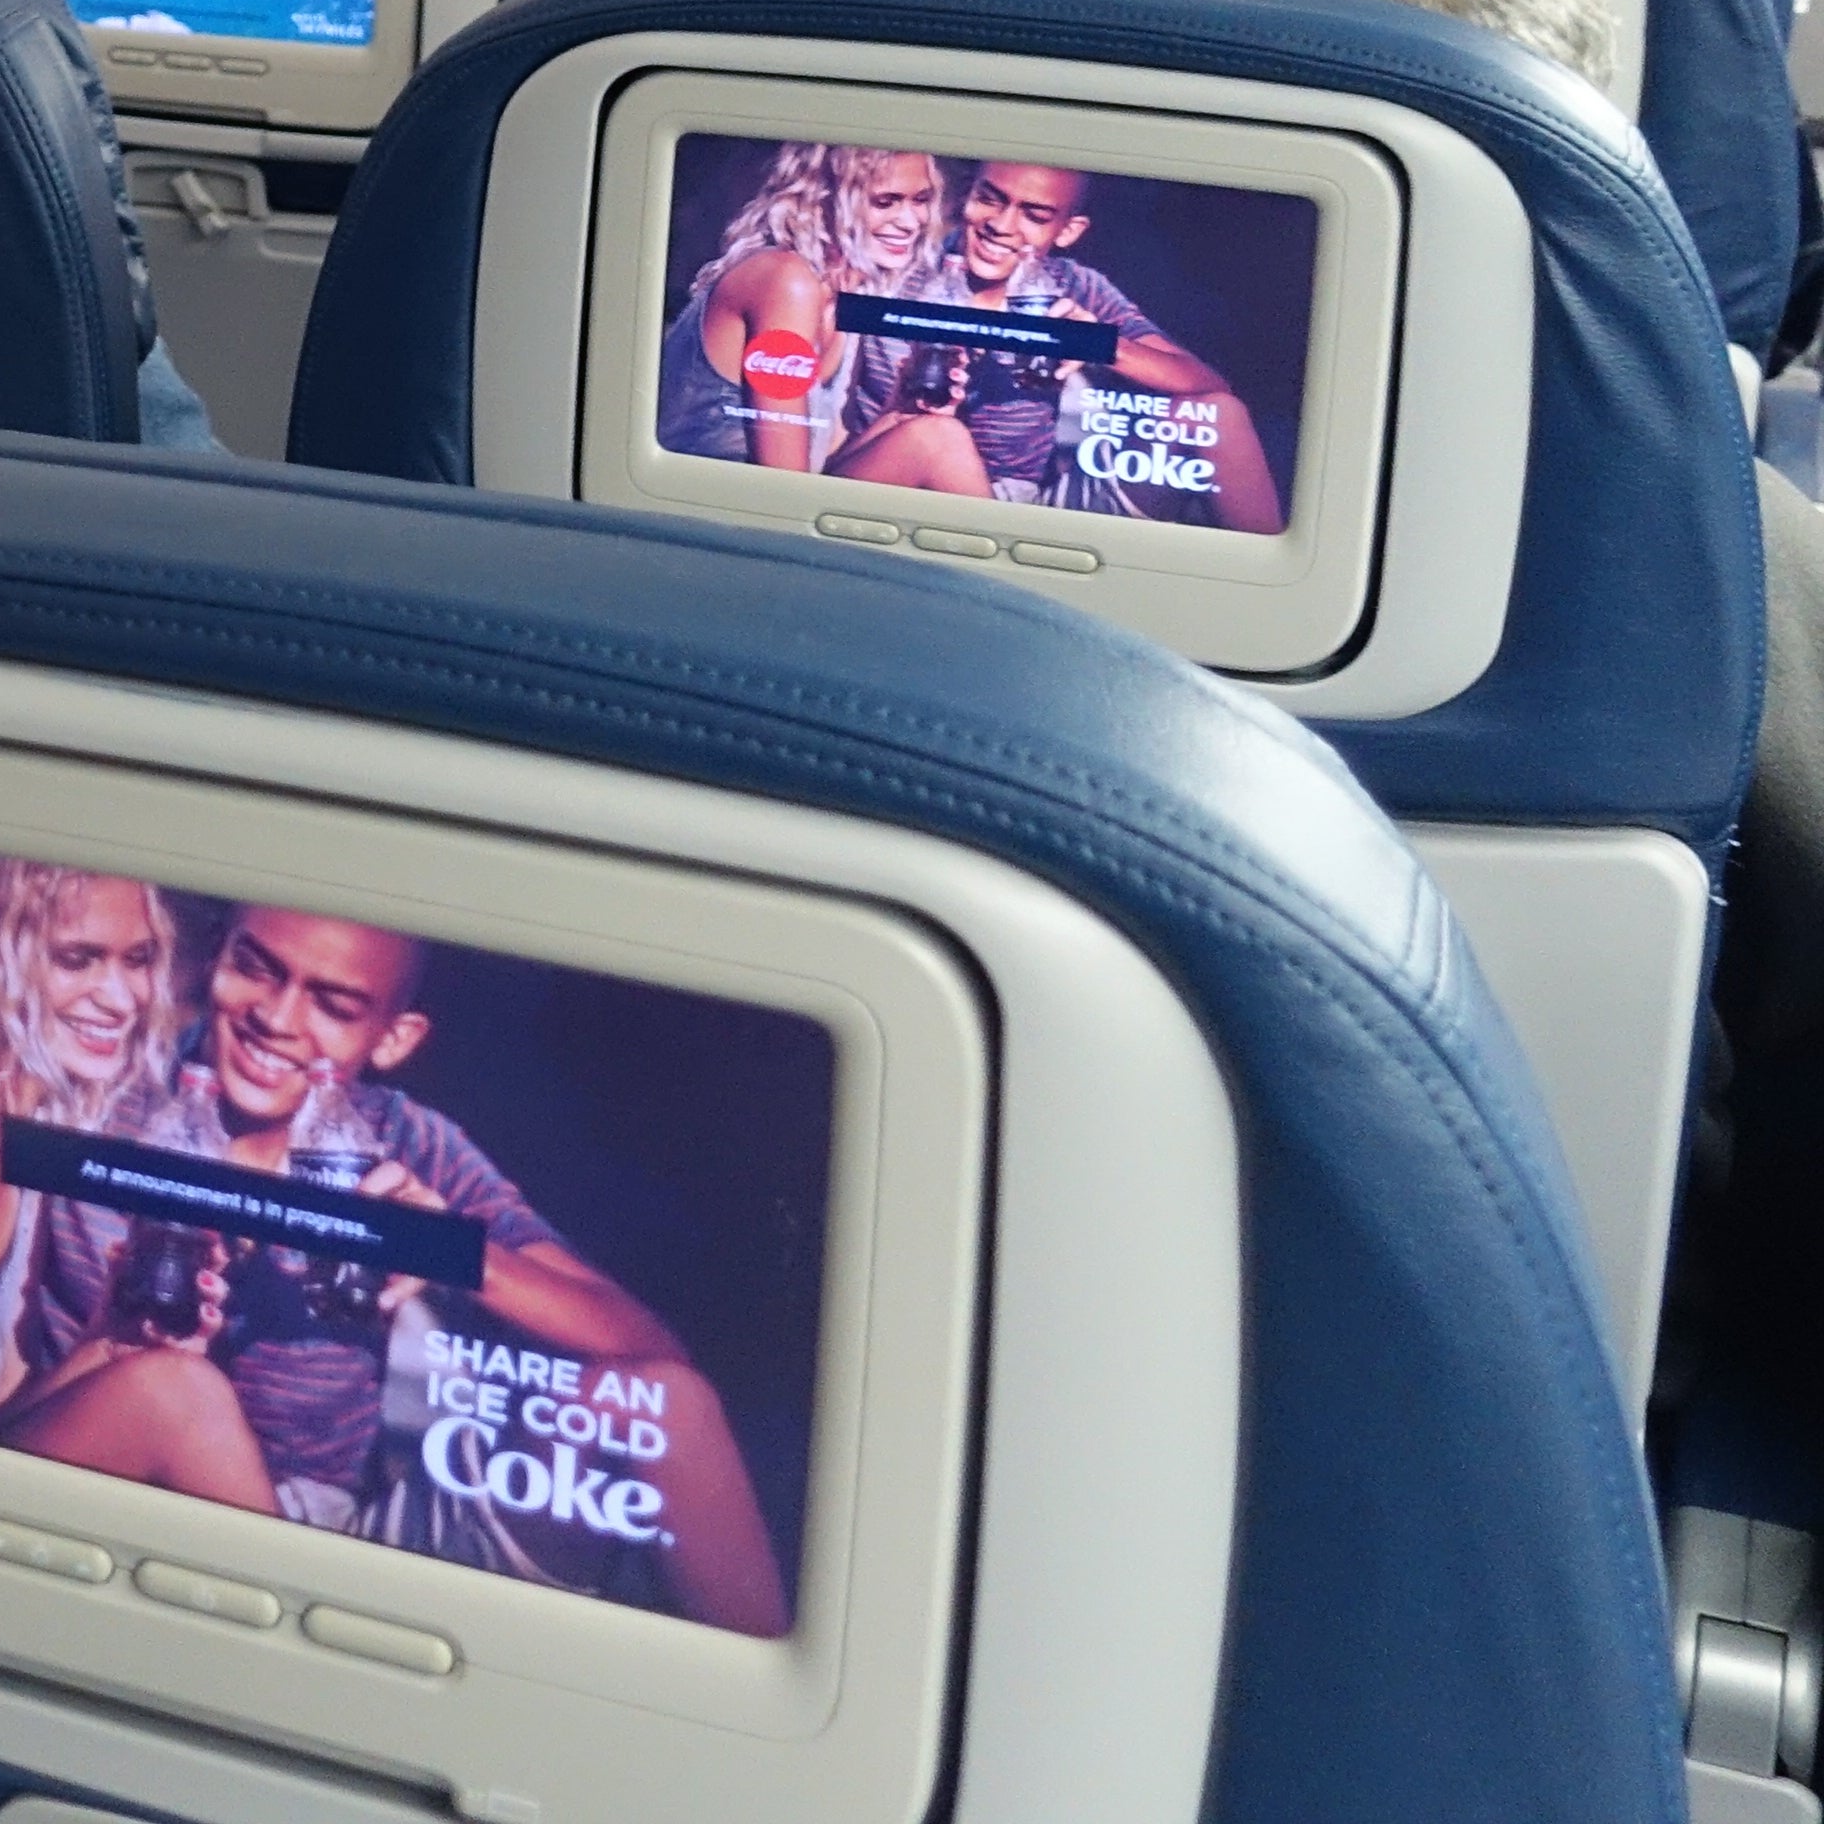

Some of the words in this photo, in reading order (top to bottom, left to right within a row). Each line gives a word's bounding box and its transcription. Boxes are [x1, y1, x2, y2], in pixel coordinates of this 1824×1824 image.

[1080, 388, 1171, 418] SHARE
[1175, 400, 1217, 424] AN
[1081, 410, 1131, 437] ICE
[1134, 417, 1219, 447] COLD
[80, 1159, 107, 1181] An
[110, 1168, 242, 1210] announcement
[244, 1194, 262, 1215] is
[264, 1199, 283, 1218] in
[424, 1329, 582, 1397] SHARE
[592, 1370, 665, 1416] AN
[426, 1370, 510, 1425] ICE
[521, 1395, 668, 1461] COLD
